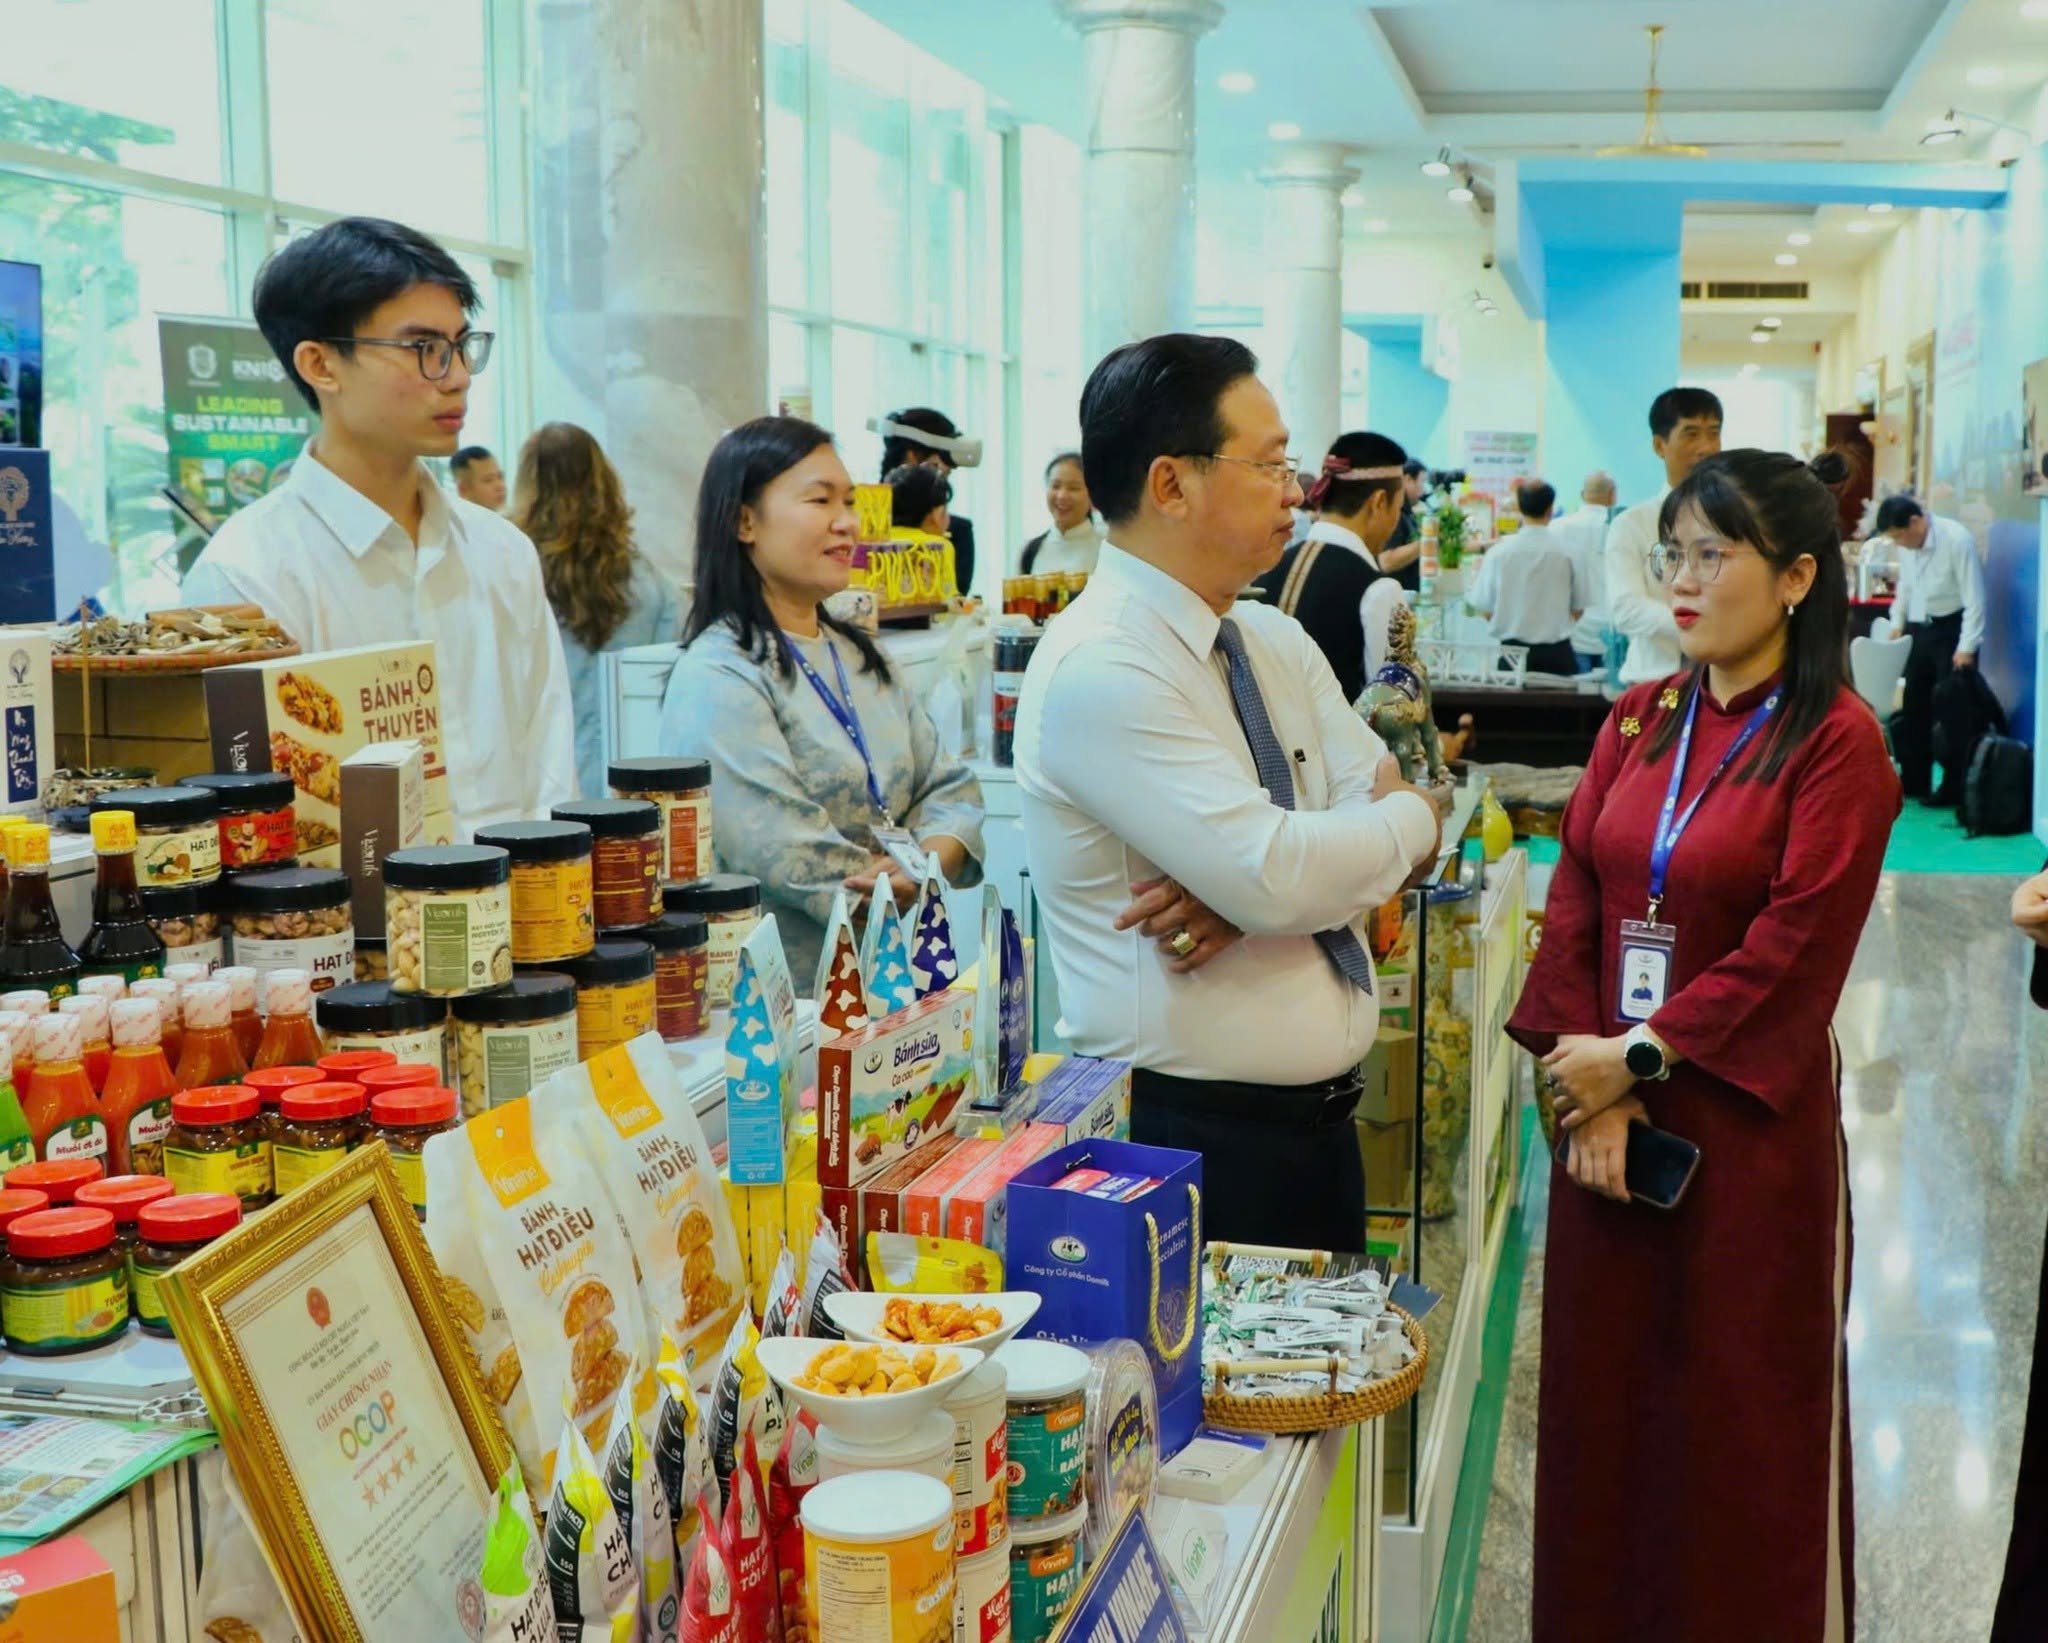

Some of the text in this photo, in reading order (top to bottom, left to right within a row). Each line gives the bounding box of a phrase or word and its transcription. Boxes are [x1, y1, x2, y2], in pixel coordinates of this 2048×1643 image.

[197, 395, 284, 415] LEADING
[172, 414, 308, 434] SUSTAINABLE
[208, 433, 280, 450] SMART
[360, 677, 414, 713] BÁNH
[894, 1038, 920, 1068] Bánh
[520, 1201, 560, 1234] BÁNH
[546, 1207, 595, 1251] ĐIỀU
[1024, 1264, 1045, 1276] Công
[1046, 1267, 1055, 1277] ty
[339, 1390, 395, 1461] OCOP
